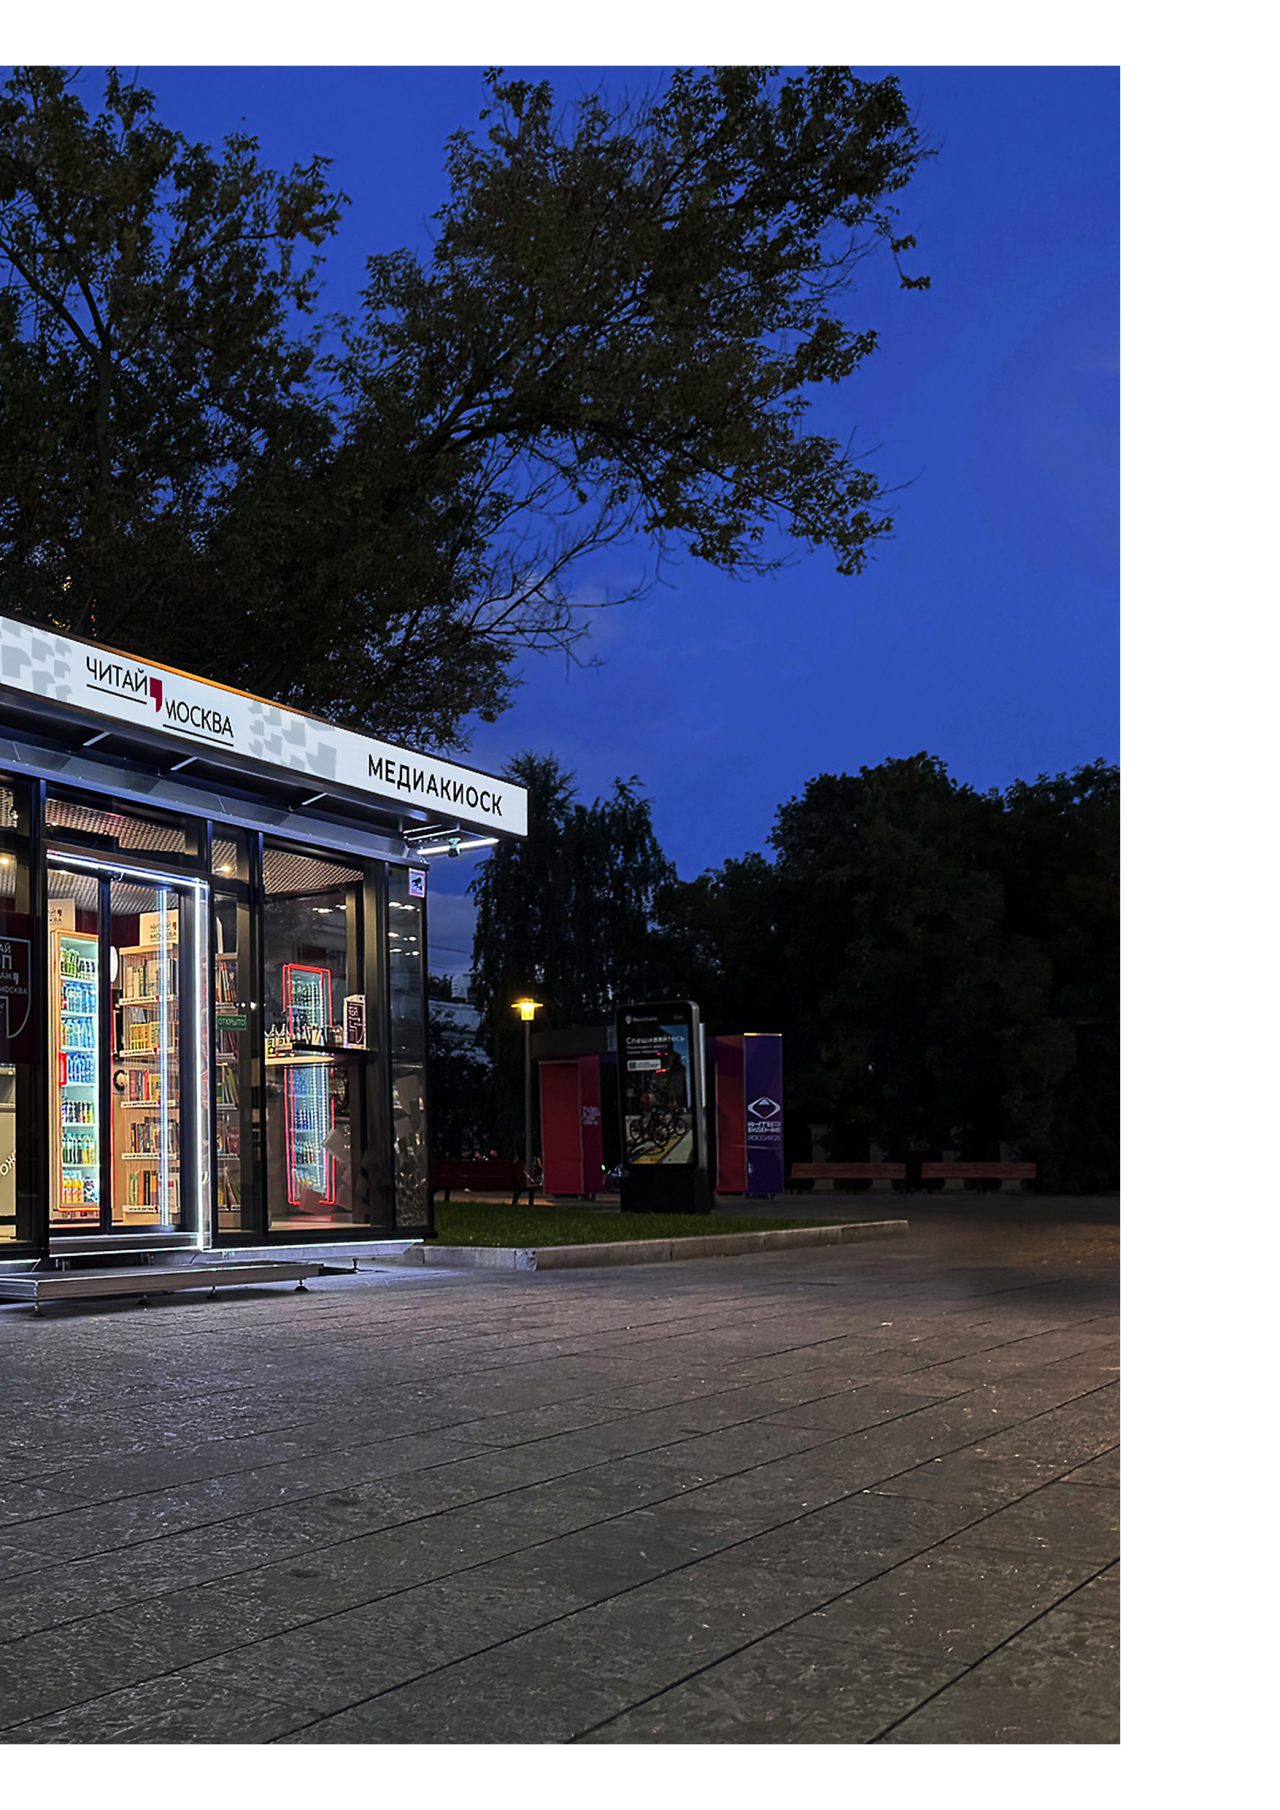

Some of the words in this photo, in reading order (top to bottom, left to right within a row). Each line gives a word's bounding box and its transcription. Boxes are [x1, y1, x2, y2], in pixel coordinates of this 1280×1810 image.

[86, 656, 148, 696] ЧИТАЙ
[165, 697, 234, 738] МОСКВА
[368, 754, 502, 816] МЕДИАКИОСК
